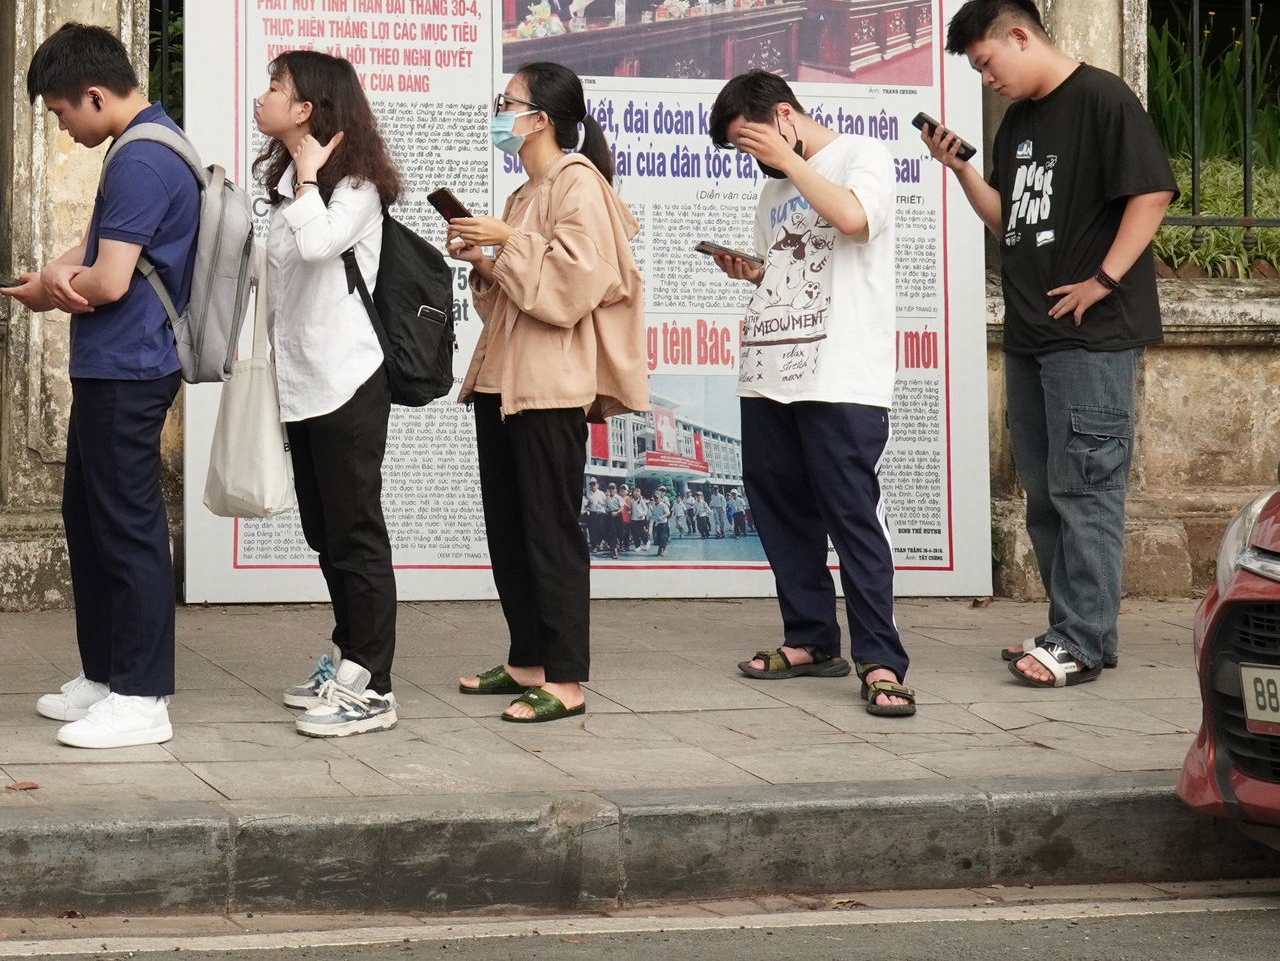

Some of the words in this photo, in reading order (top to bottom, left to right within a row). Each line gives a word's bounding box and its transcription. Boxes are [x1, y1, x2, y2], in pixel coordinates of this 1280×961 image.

[451, 0, 481, 20] 30-4,
[370, 69, 394, 91] CỦA
[398, 70, 430, 93] ĐẢNG
[624, 101, 649, 141] đại
[654, 102, 694, 135] đoàn
[870, 108, 898, 140] nên
[636, 143, 666, 177] của
[671, 145, 700, 178] dân
[705, 145, 731, 187] tộc
[754, 308, 827, 337] MEOWMENT
[662, 322, 692, 365] tên
[904, 328, 938, 369] mới
